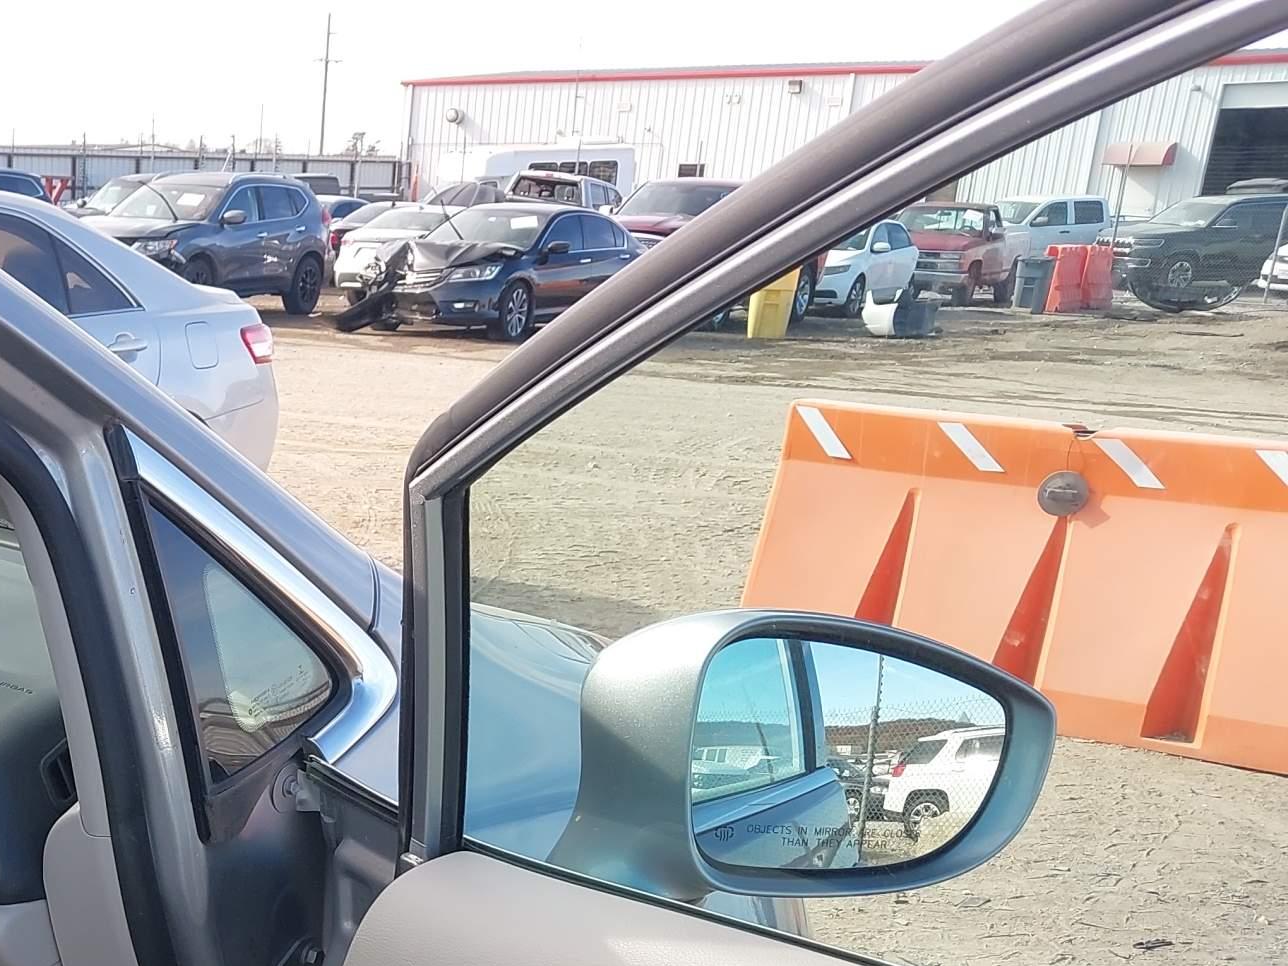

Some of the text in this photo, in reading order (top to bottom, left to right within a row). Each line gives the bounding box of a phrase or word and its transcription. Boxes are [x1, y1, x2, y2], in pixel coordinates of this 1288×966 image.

[746, 824, 792, 835] OBJECTS
[797, 826, 808, 836] IN
[814, 826, 853, 838] MIRROR
[781, 836, 888, 849] THAN THEY APPEAR
